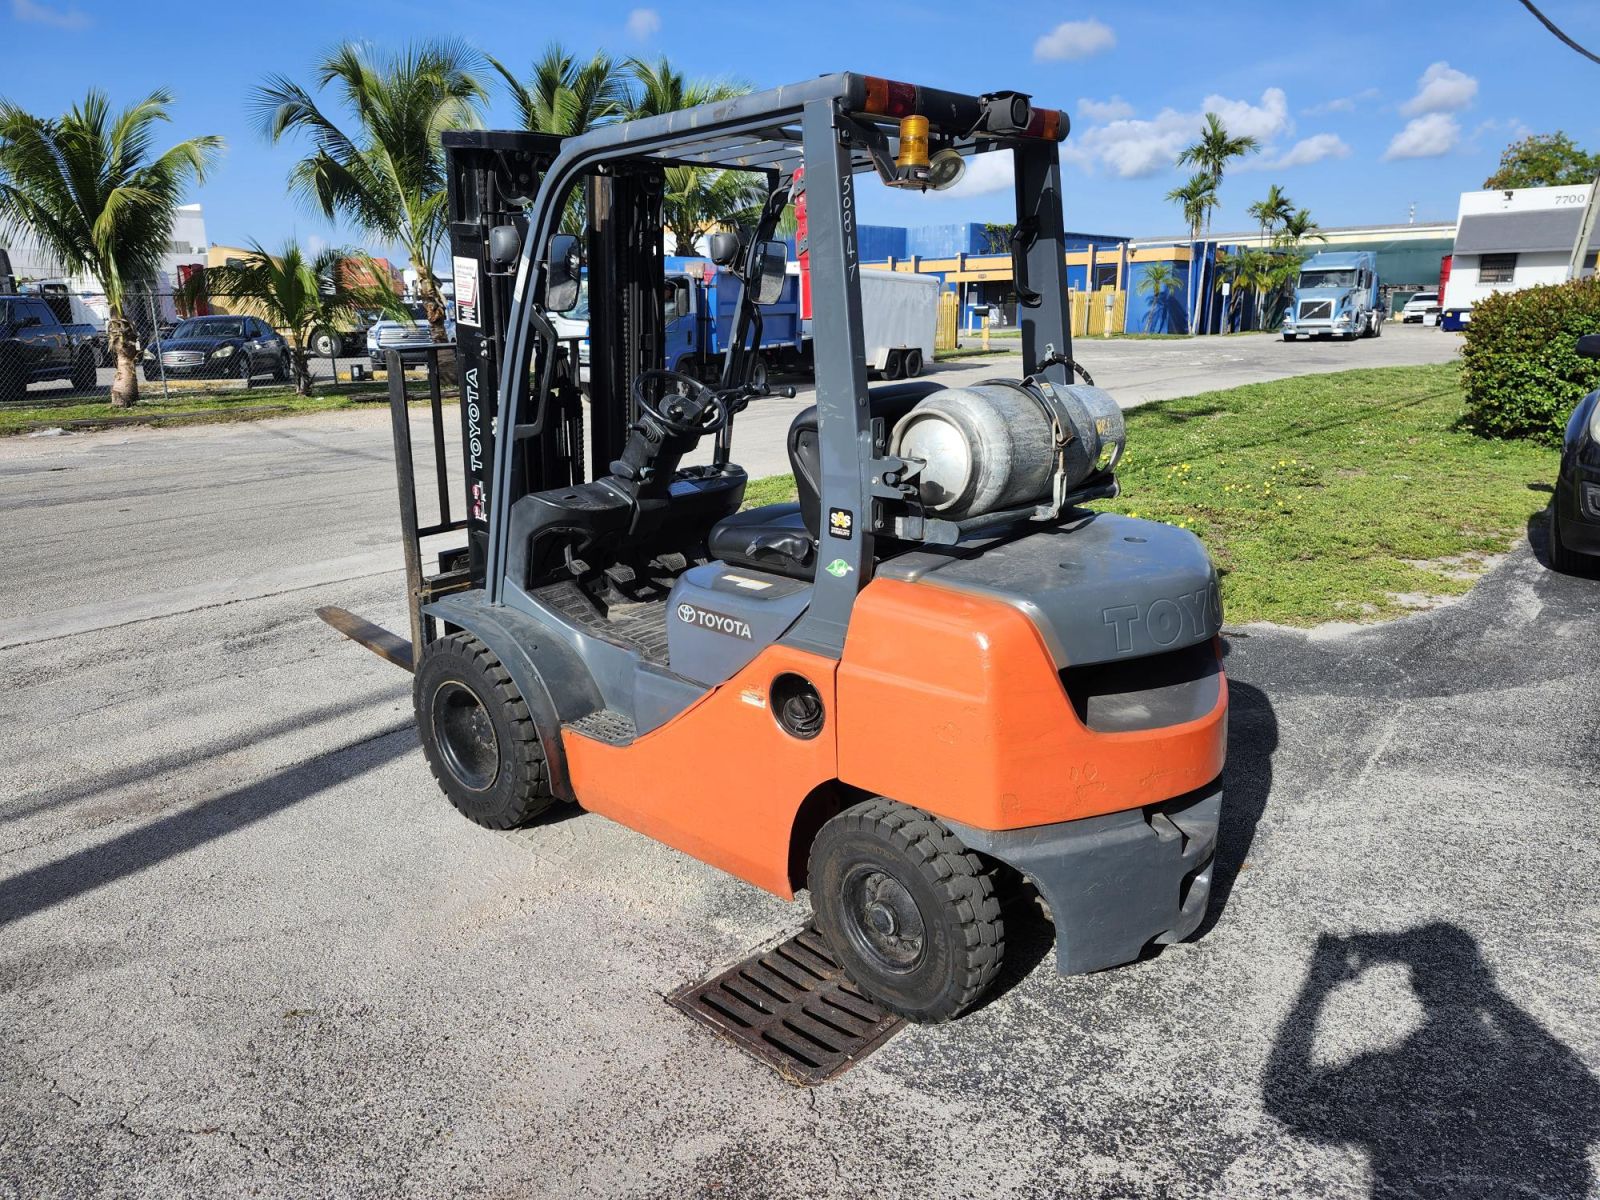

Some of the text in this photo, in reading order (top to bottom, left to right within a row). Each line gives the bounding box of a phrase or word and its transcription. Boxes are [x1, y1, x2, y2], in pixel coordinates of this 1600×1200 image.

[1555, 194, 1585, 205] 7700
[466, 367, 483, 471] TOYOTA
[830, 511, 852, 528] SAS
[697, 610, 752, 639] TOYOTA
[1102, 581, 1222, 653] TOYO
